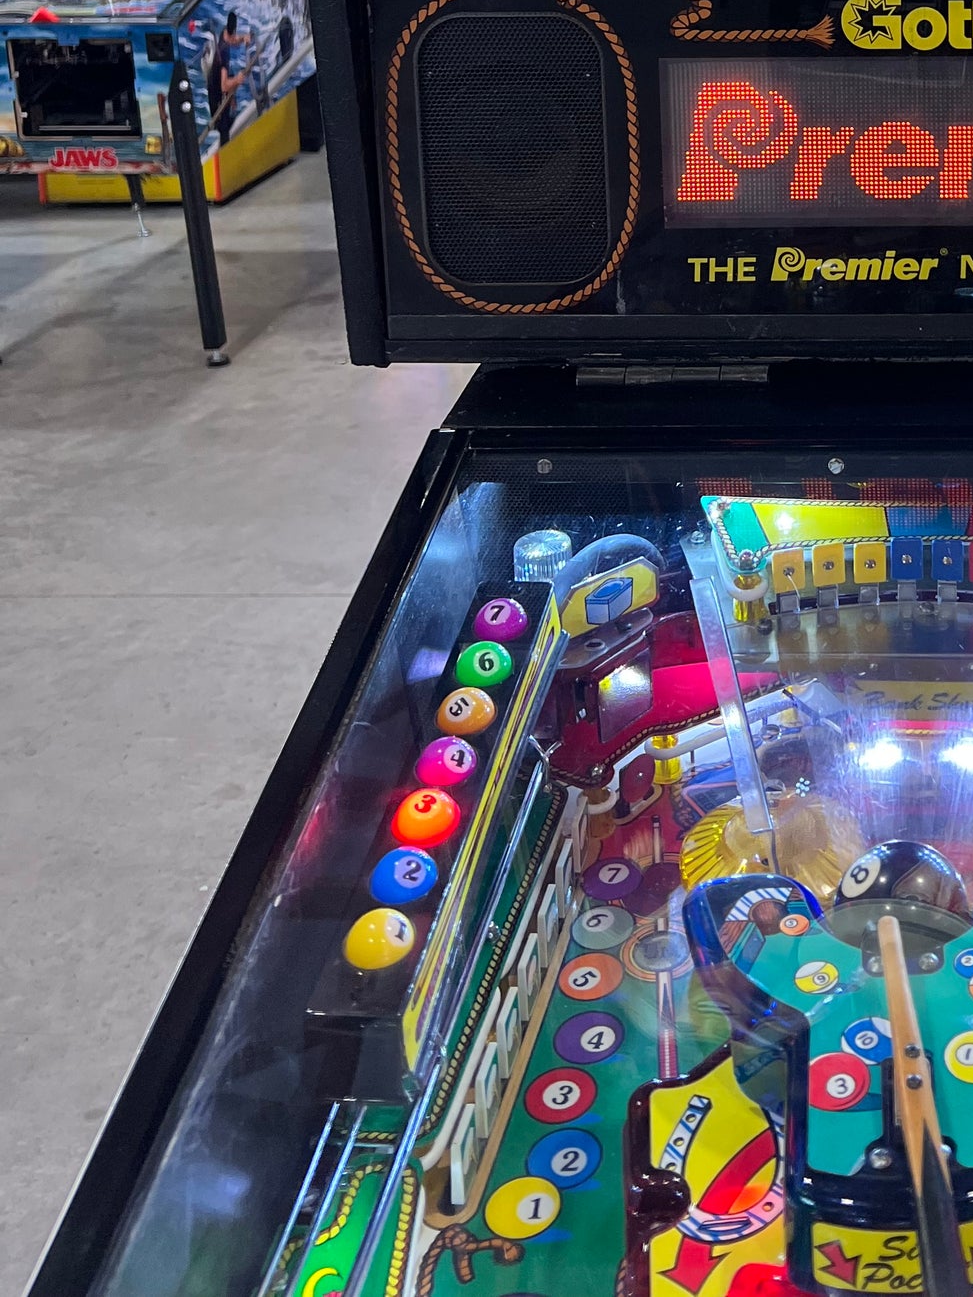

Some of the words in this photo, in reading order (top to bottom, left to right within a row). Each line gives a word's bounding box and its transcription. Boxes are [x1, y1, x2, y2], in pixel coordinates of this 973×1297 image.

[49, 147, 118, 170] JAWS
[688, 256, 756, 282] THE
[489, 605, 505, 622] 7
[478, 652, 494, 672] 6
[449, 697, 470, 717] 5
[450, 749, 466, 768] 4
[414, 794, 437, 813] 3
[402, 859, 422, 882] 2
[607, 867, 622, 882] 7
[850, 865, 869, 884] 8
[393, 916, 408, 942] 1
[586, 913, 609, 928] 6
[572, 970, 597, 987] 5
[587, 1031, 604, 1049] 4
[857, 1033, 873, 1046] 10
[552, 1085, 573, 1105] 3
[834, 1077, 848, 1095] 3
[560, 1150, 580, 1172] 2
[528, 1198, 542, 1220] 1
